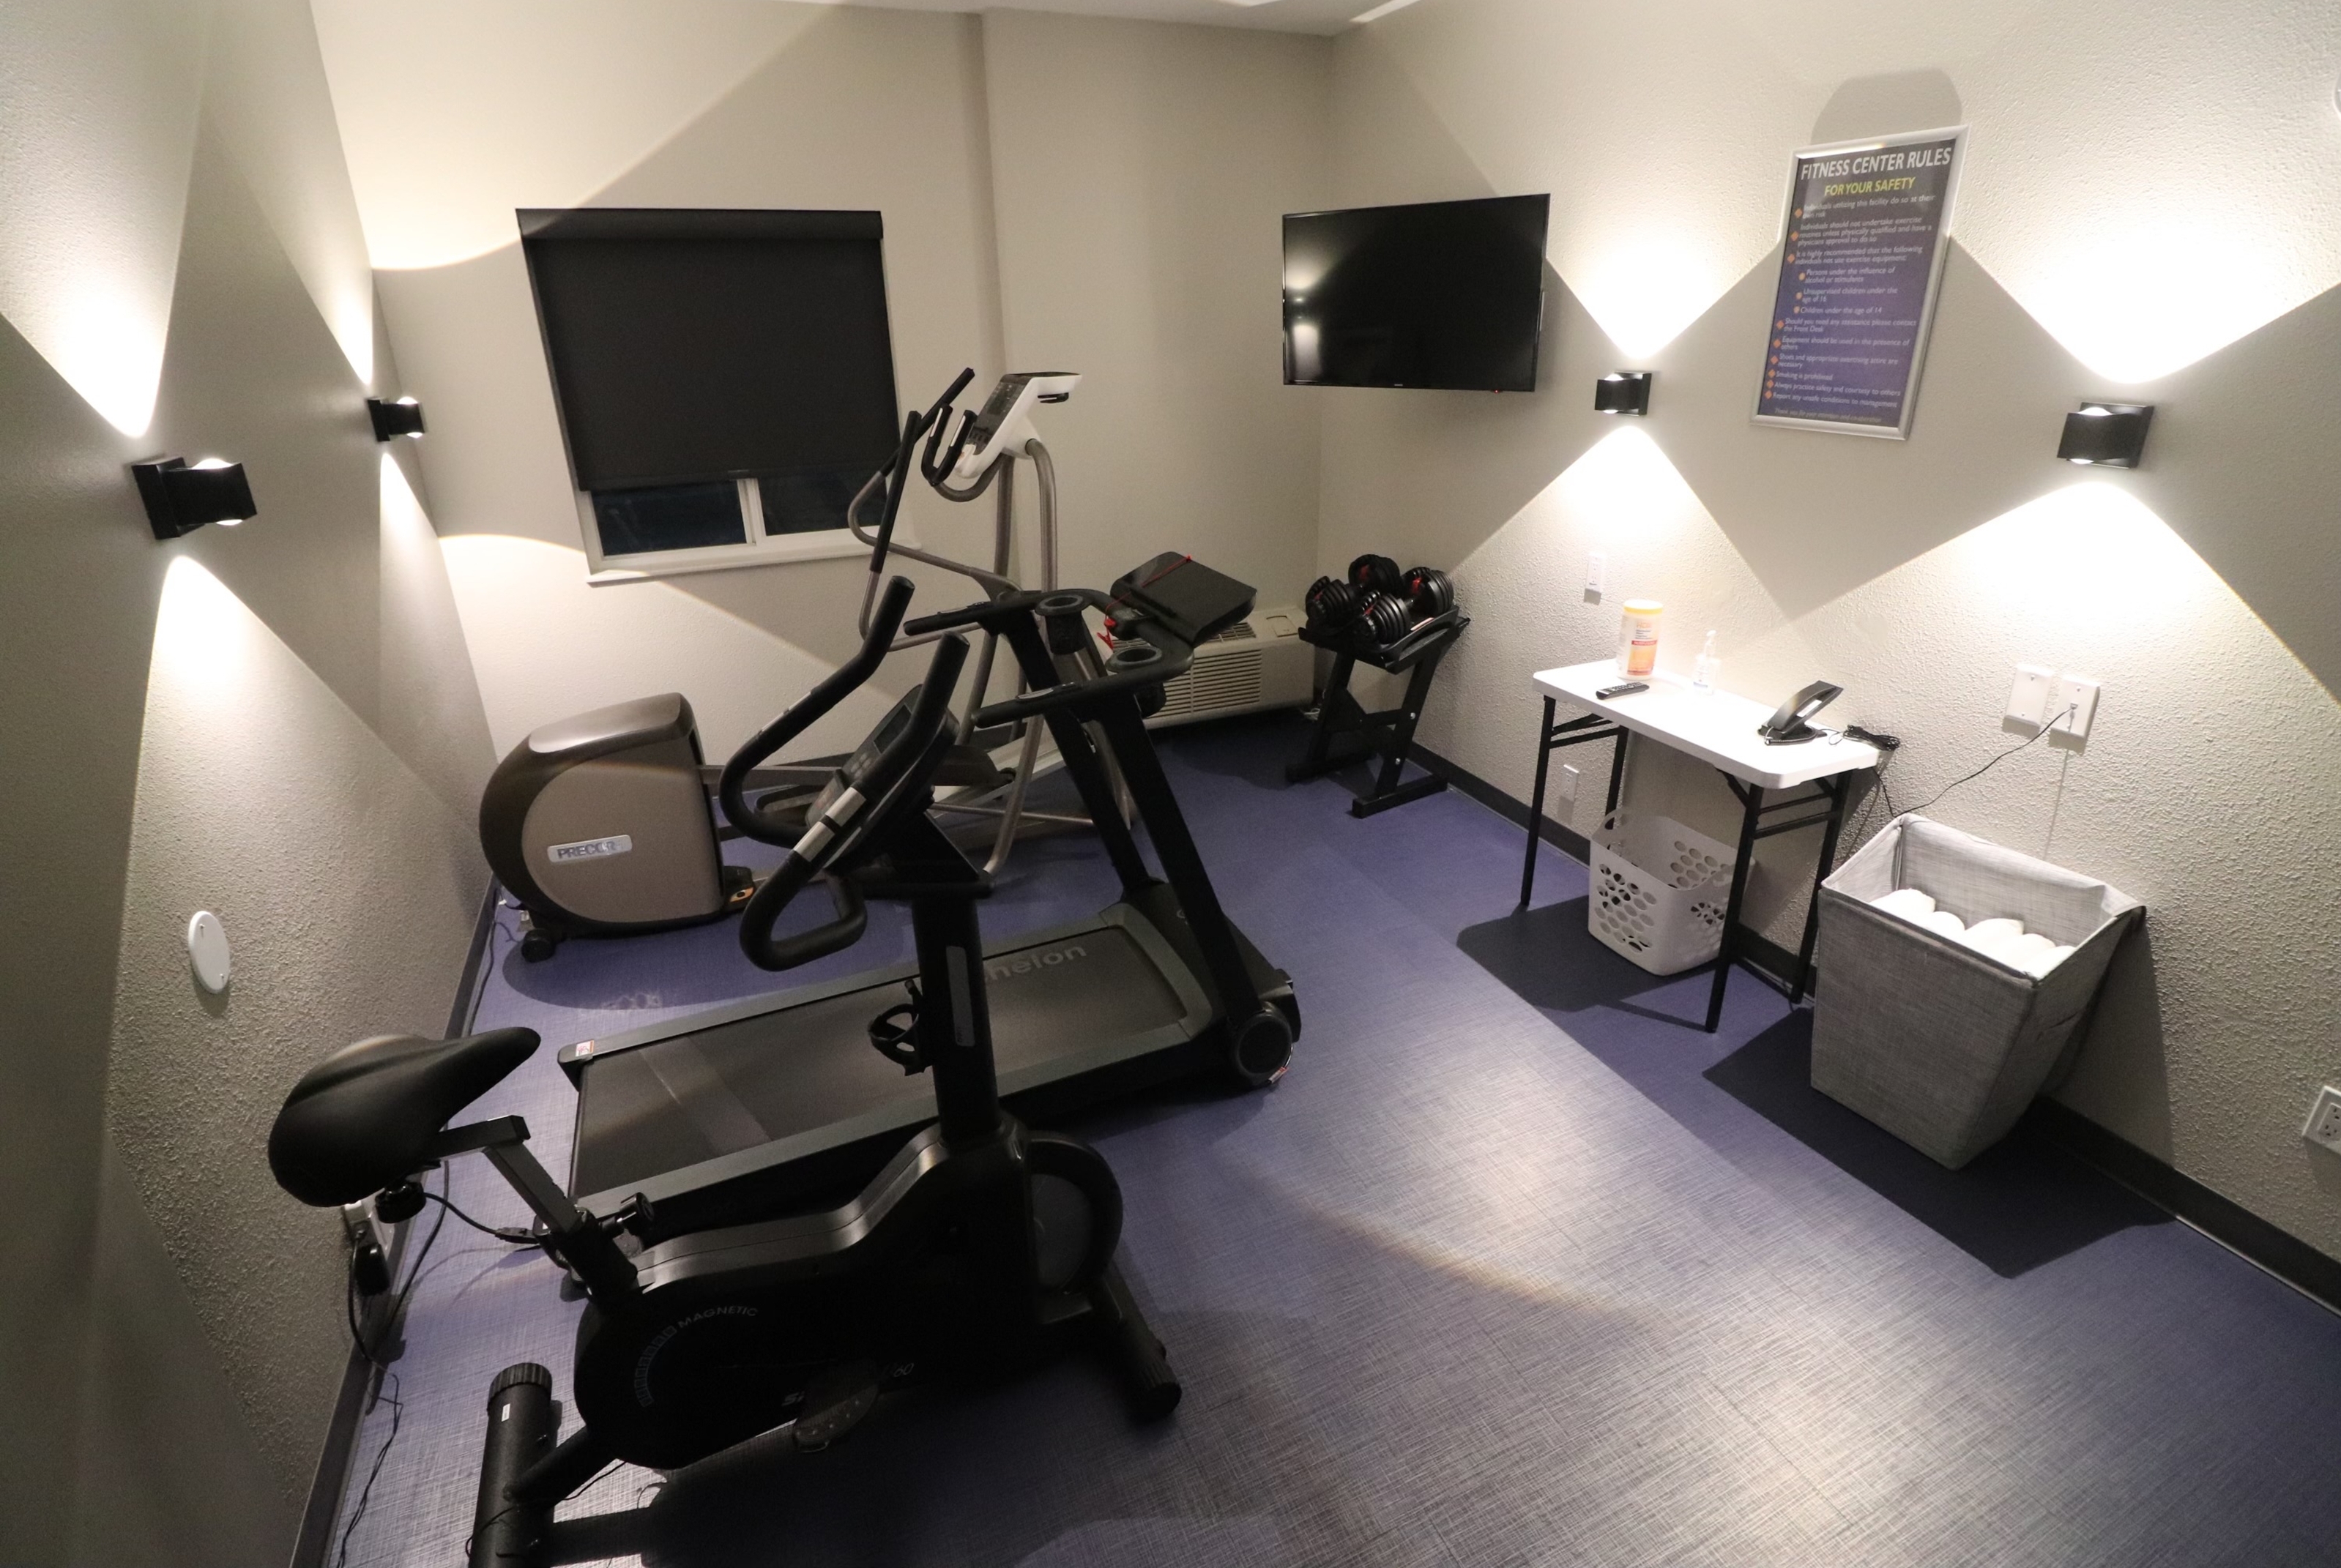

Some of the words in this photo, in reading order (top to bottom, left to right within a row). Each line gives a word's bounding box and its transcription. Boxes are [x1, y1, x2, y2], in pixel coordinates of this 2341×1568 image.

[1801, 159, 1850, 180] FITNESS
[1853, 152, 1905, 175] CENTER
[1907, 147, 1951, 169] RULES
[1824, 184, 1845, 197] FOR
[1845, 181, 1872, 195] YOUR
[1875, 176, 1916, 192] SAFETY
[1833, 201, 1856, 209] utilizing
[1869, 198, 1888, 206] facility
[1890, 196, 1899, 204] do
[1918, 194, 1936, 202] their
[1829, 220, 1849, 228] should
[1861, 217, 1894, 226] undertake
[1840, 228, 1869, 239] physically
[1869, 225, 1897, 235] qualified
[1825, 238, 1850, 246] approval
[1806, 250, 1823, 259] highly
[1823, 247, 1867, 255] recommended
[1867, 247, 1880, 255] that
[1894, 245, 1923, 254] following
[1829, 267, 1847, 275] under
[1858, 266, 1886, 275] influence
[1888, 266, 1896, 274] of
[1804, 288, 1841, 296] Unsupervised
[1867, 286, 1886, 294] under
[1887, 286, 1898, 294] the
[1854, 307, 1865, 316] age
[1866, 306, 1874, 314] of
[557, 841, 616, 859] PRECOR
[983, 944, 1087, 982] helon
[677, 1305, 759, 1329] MAGNETIC
